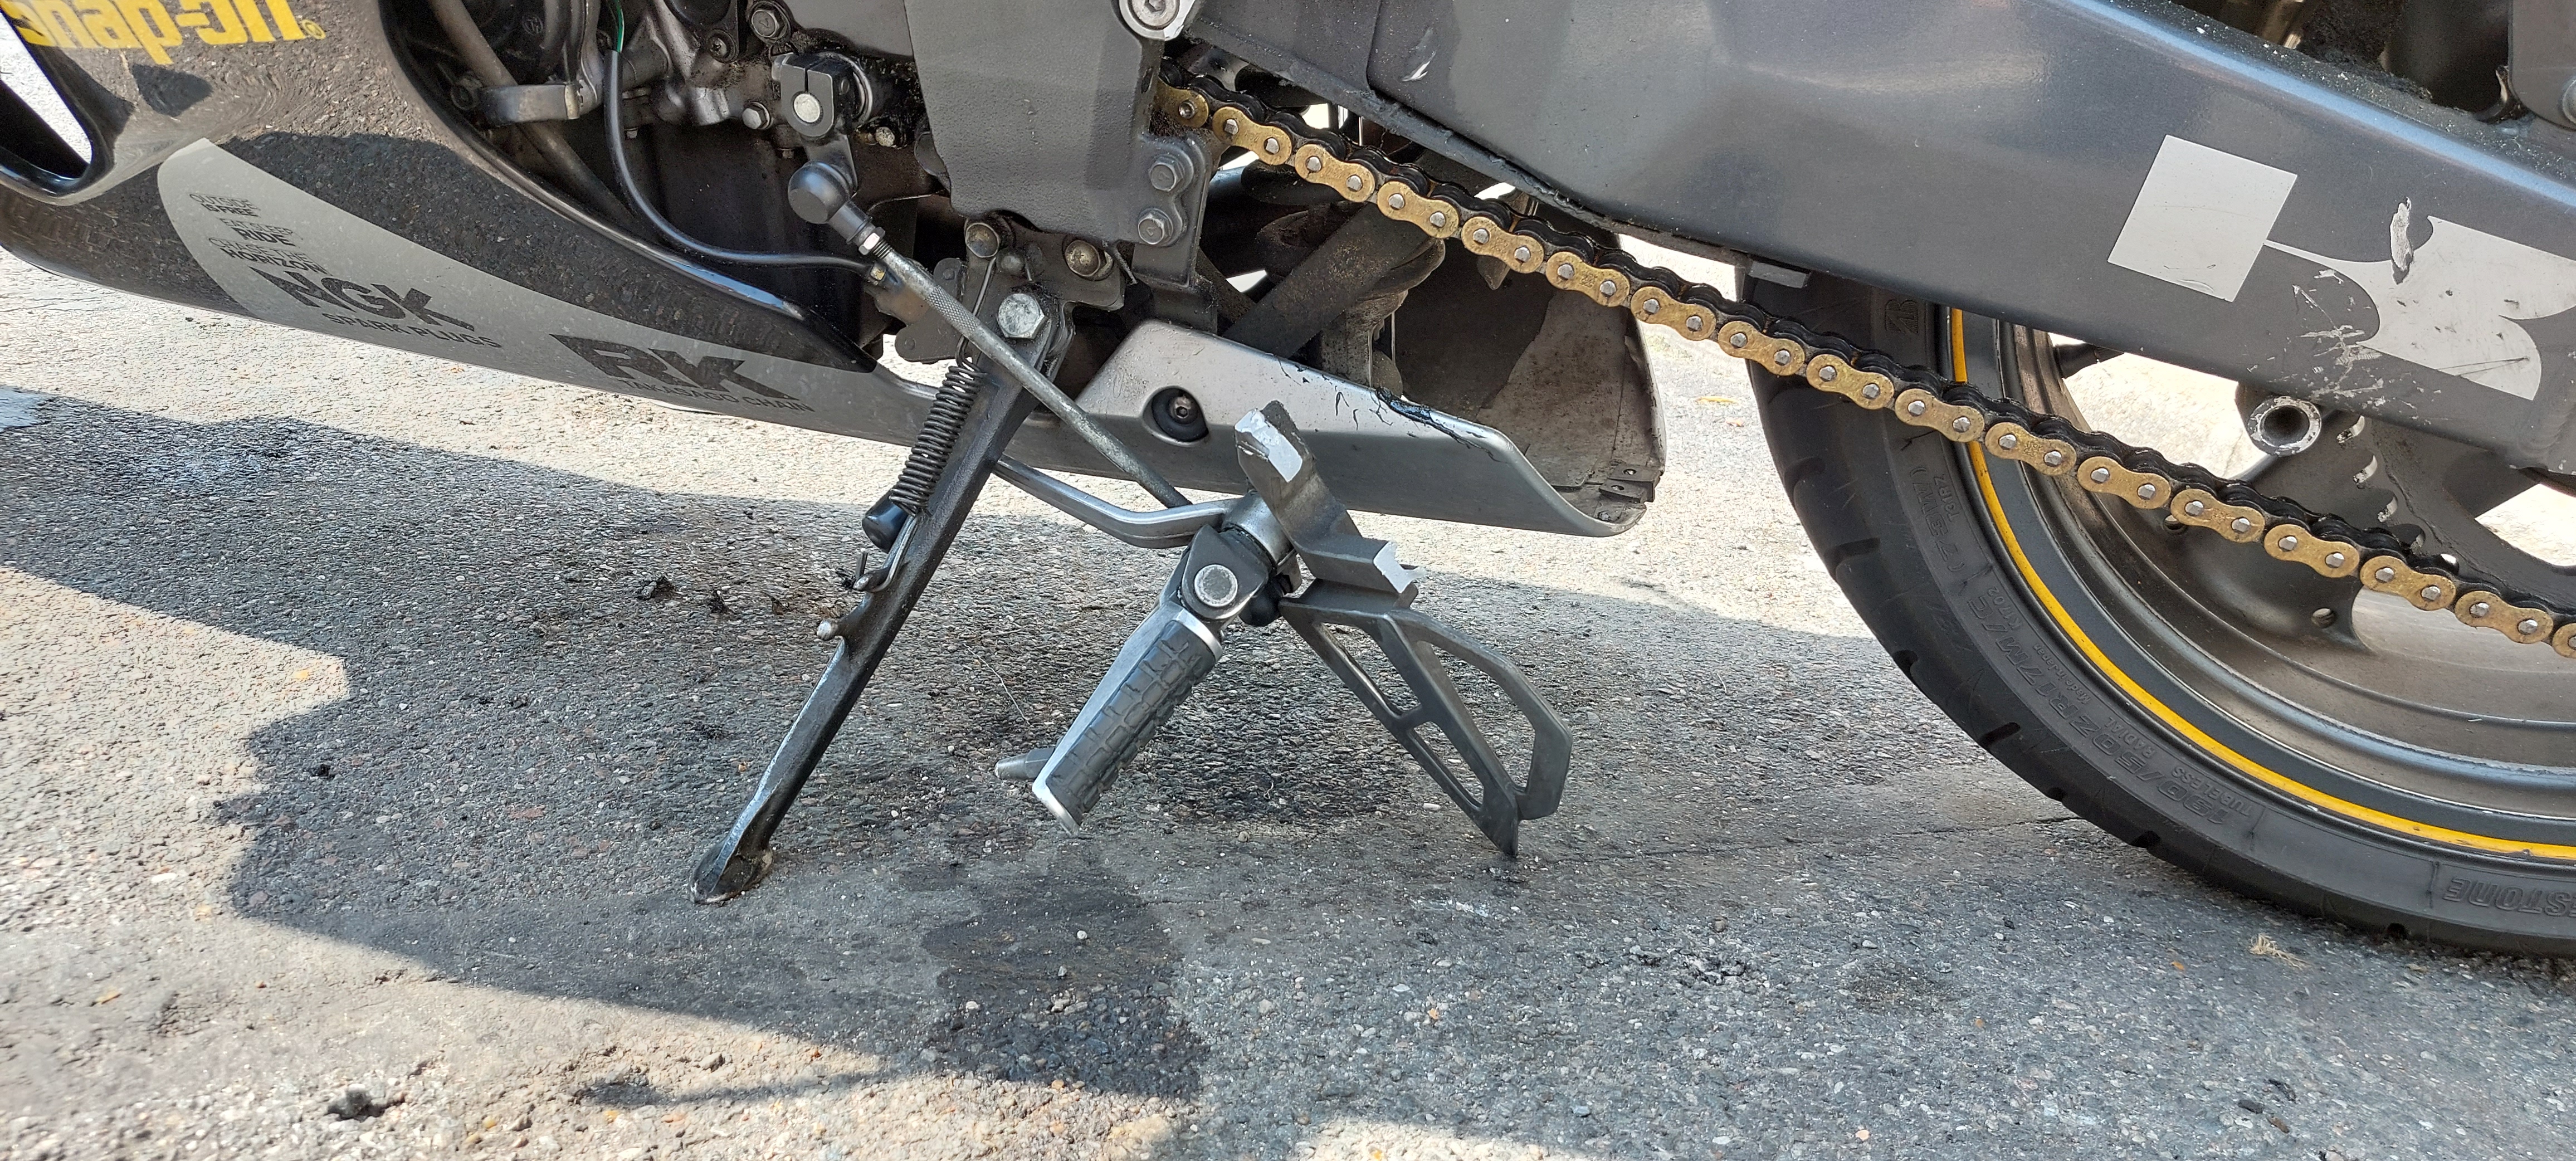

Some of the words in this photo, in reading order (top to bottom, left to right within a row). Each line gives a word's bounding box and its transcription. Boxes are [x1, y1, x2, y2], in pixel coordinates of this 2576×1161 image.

[189, 194, 261, 211] OUTSIDE
[215, 205, 258, 217] FREE
[231, 226, 296, 247] RIDE
[208, 238, 276, 257] CHASE
[270, 248, 314, 264] THE
[219, 247, 329, 275] HORIZON
[249, 266, 475, 331] NGK
[321, 313, 412, 334] SPARK
[407, 325, 502, 349] PLUGS
[548, 333, 800, 401] RK
[743, 396, 816, 413] CHAIN
[2066, 678, 2091, 705] Made
[2105, 716, 2156, 759] RADIAL
[2171, 765, 2252, 817] TUBELESS
